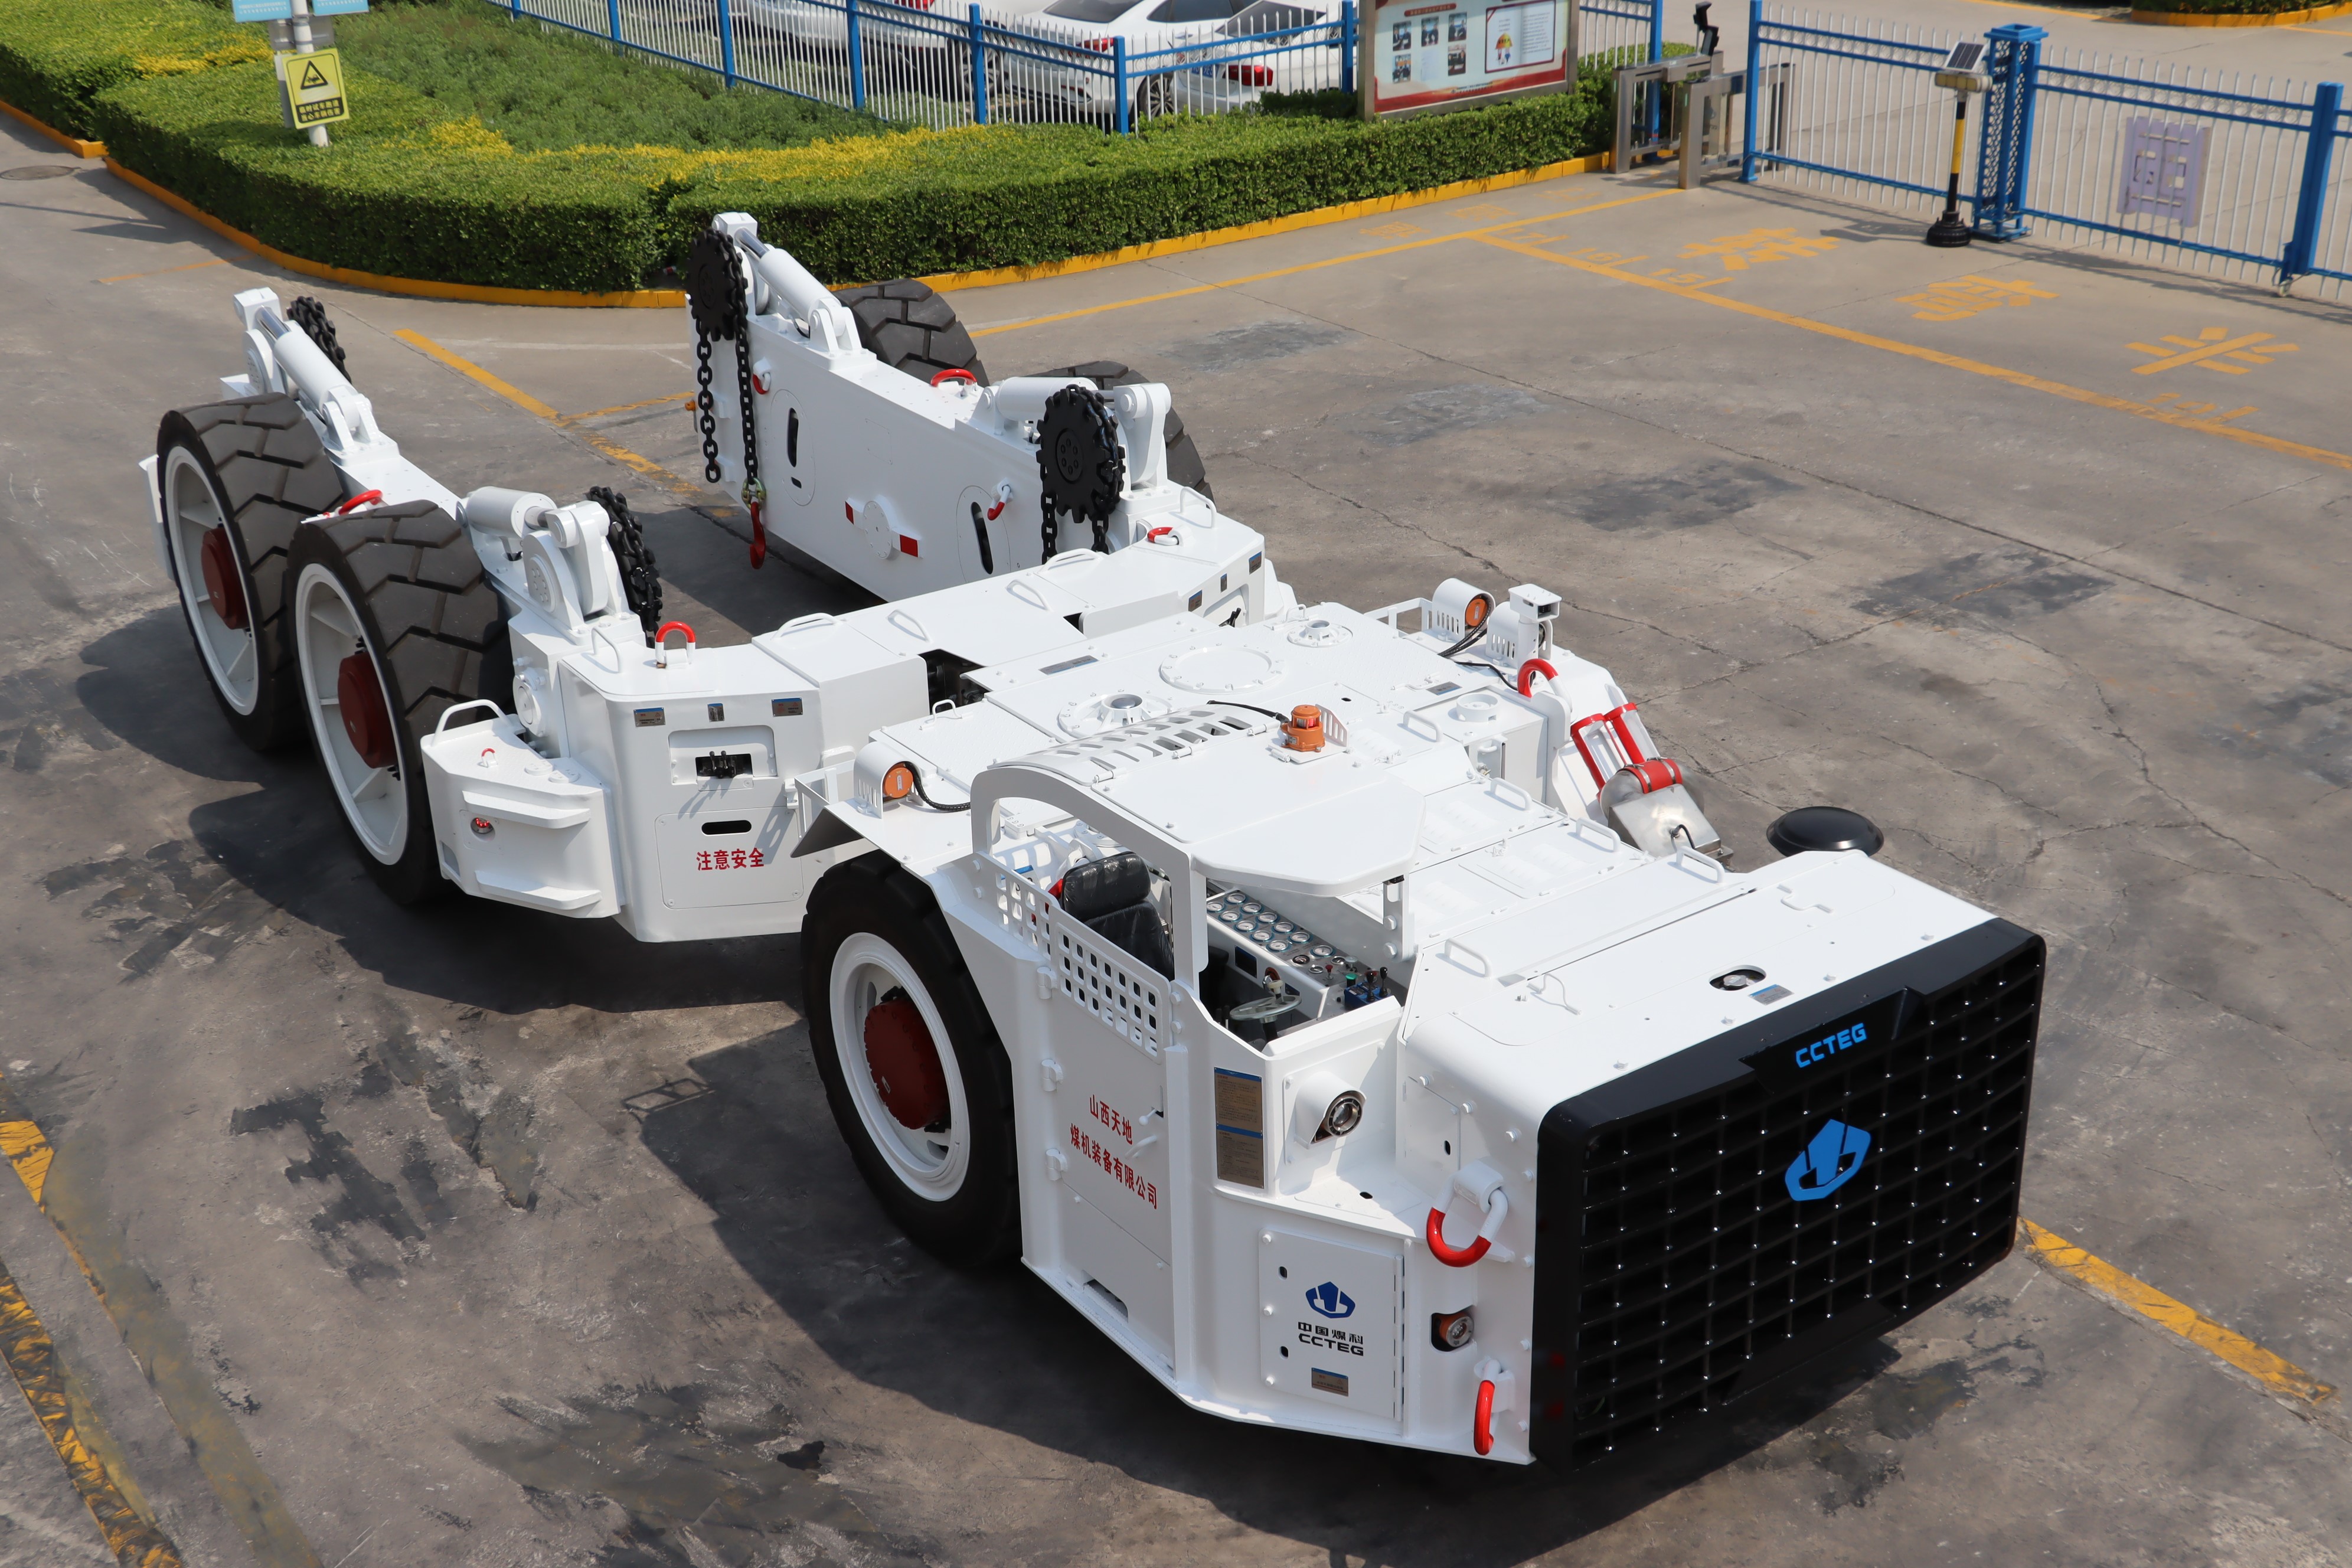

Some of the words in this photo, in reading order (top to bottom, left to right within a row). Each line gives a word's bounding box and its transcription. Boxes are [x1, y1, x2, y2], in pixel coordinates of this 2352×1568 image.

[1497, 228, 1547, 240] 17
[1568, 247, 1622, 262] 16
[1649, 268, 1707, 283] 15
[697, 847, 764, 871] 注意安全
[1795, 1023, 1867, 1068] CCTEG
[1089, 1094, 1133, 1145] 山西天地
[1070, 1122, 1157, 1210] 煤机装备有限公司
[1298, 1321, 1364, 1345] 中国煤科
[1298, 1333, 1364, 1357] CCTEG
